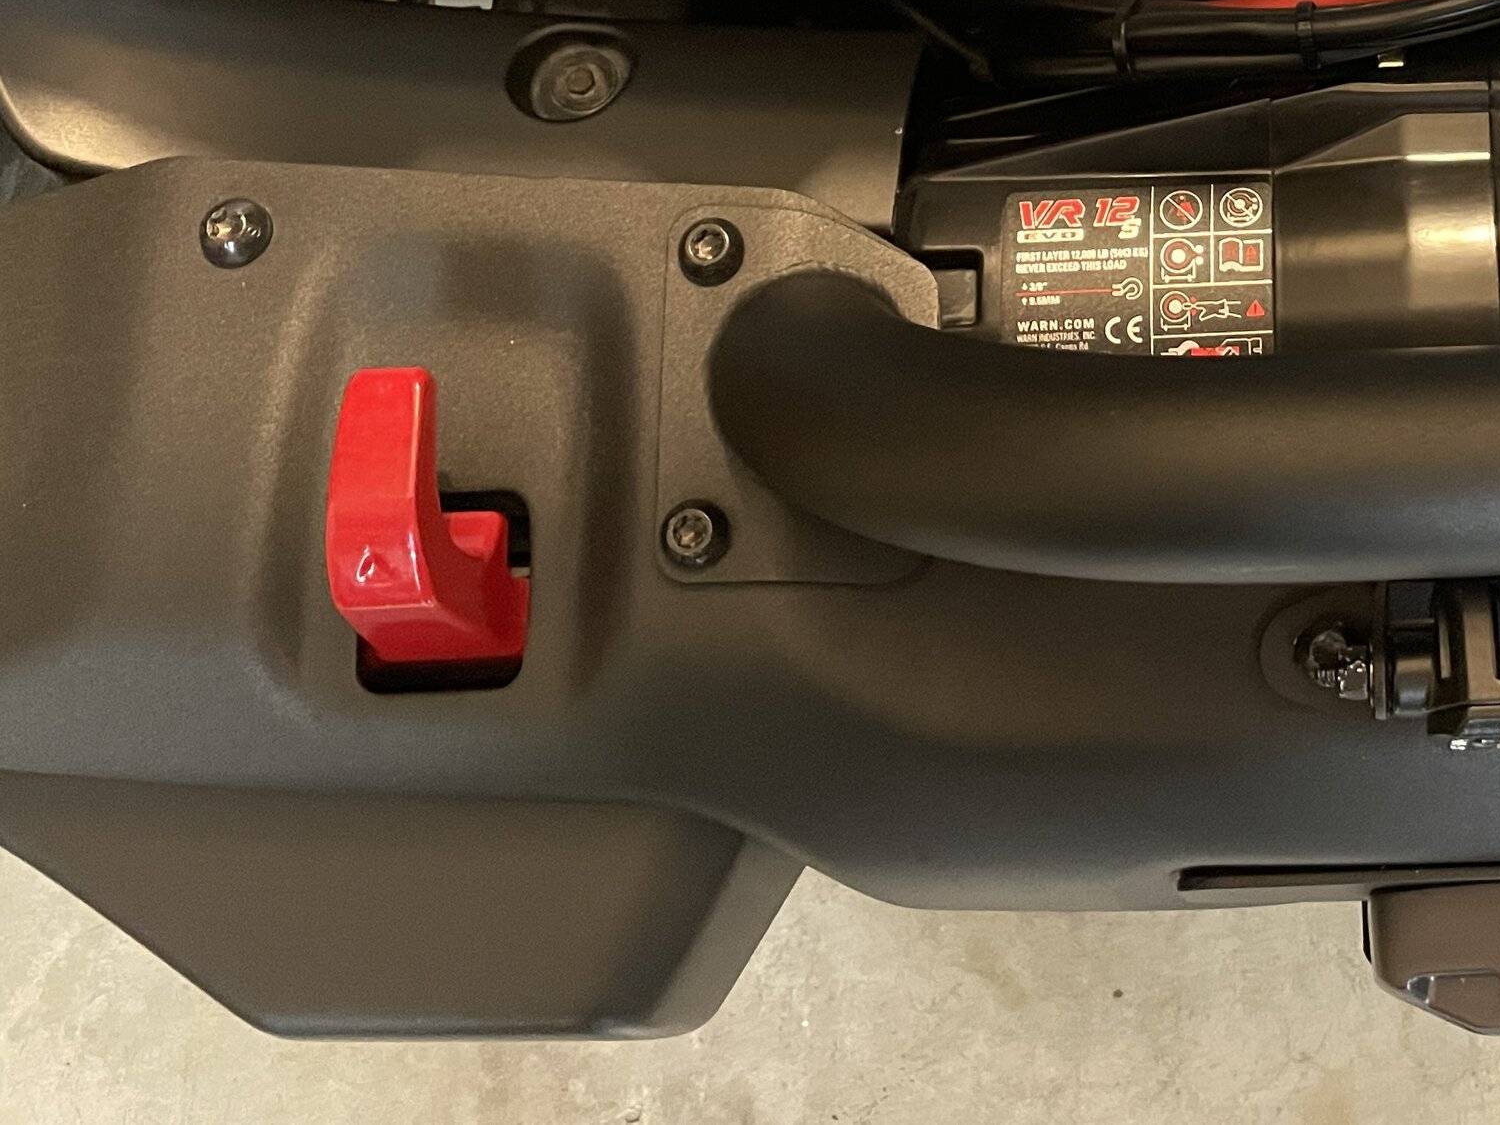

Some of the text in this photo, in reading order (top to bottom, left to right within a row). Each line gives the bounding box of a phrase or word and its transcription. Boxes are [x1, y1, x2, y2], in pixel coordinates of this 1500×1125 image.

[1019, 196, 1140, 229] VR 12
[1020, 230, 1080, 242] EVO
[1016, 252, 1041, 262] FIRST
[1042, 250, 1070, 261] LAYER
[1097, 249, 1109, 259] LB
[1016, 260, 1127, 274] NEVER EXCEED THIS LOAD
[1017, 318, 1095, 332] WARN.COM
[1104, 315, 1143, 344] CE
[1017, 334, 1038, 342] WARN
